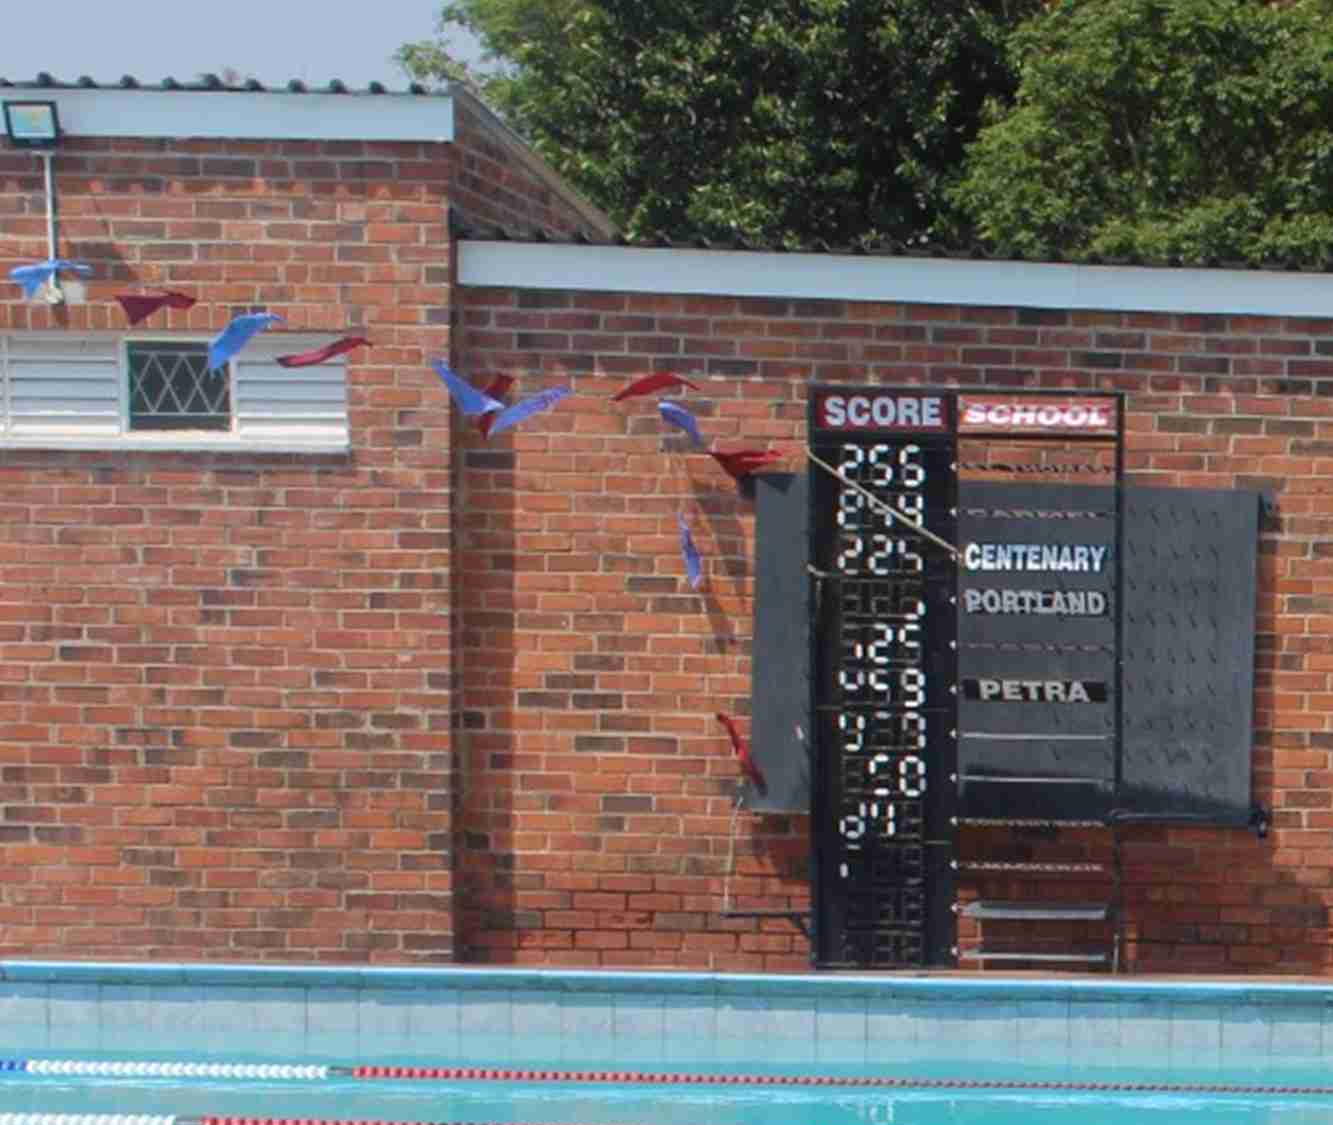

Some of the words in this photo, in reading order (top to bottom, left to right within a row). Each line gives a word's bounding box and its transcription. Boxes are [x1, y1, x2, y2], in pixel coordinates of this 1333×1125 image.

[824, 397, 943, 427] SCORE
[963, 404, 1108, 426] SCHOOL
[964, 543, 1105, 572] CENTENARY
[964, 589, 1105, 615] PORTLAND
[979, 679, 1090, 703] PETRA
